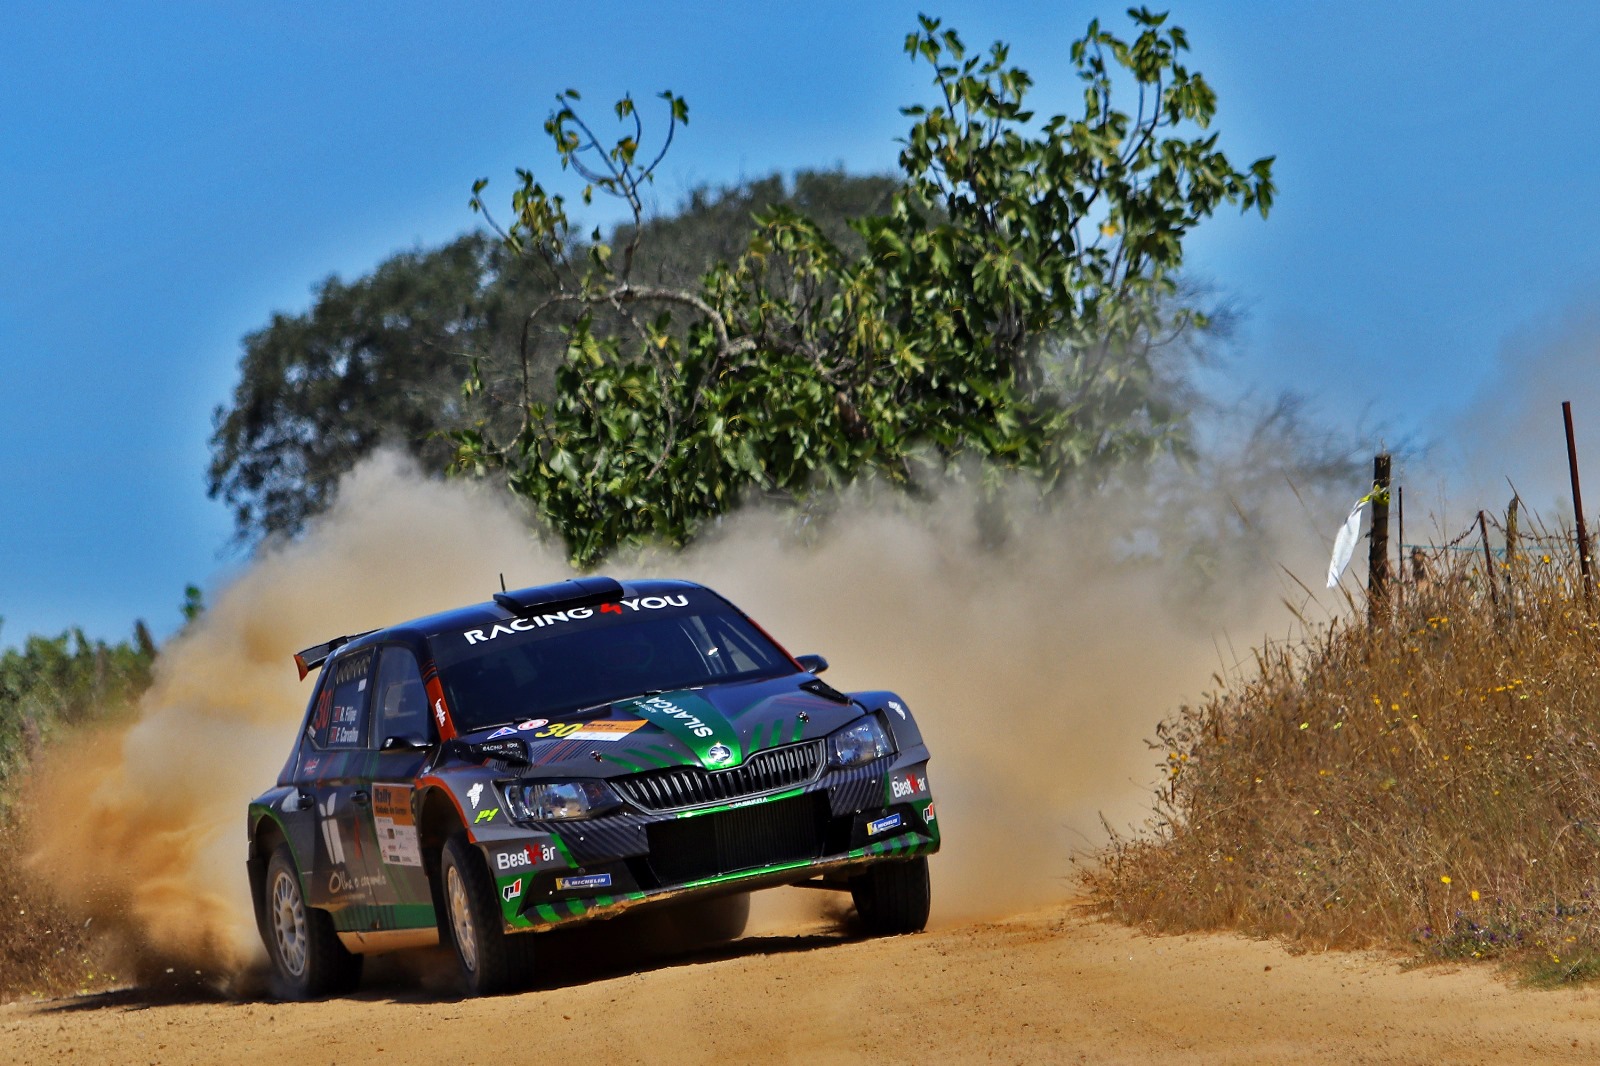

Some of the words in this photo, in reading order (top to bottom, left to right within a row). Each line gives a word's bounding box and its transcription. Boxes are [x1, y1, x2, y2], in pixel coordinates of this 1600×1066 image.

[463, 607, 594, 645] RACING
[645, 696, 714, 738] SILARCA
[535, 722, 585, 738] 30
[374, 788, 392, 806] Rally
[877, 818, 897, 828] MICHELIN
[571, 877, 606, 886] MICHELIN
